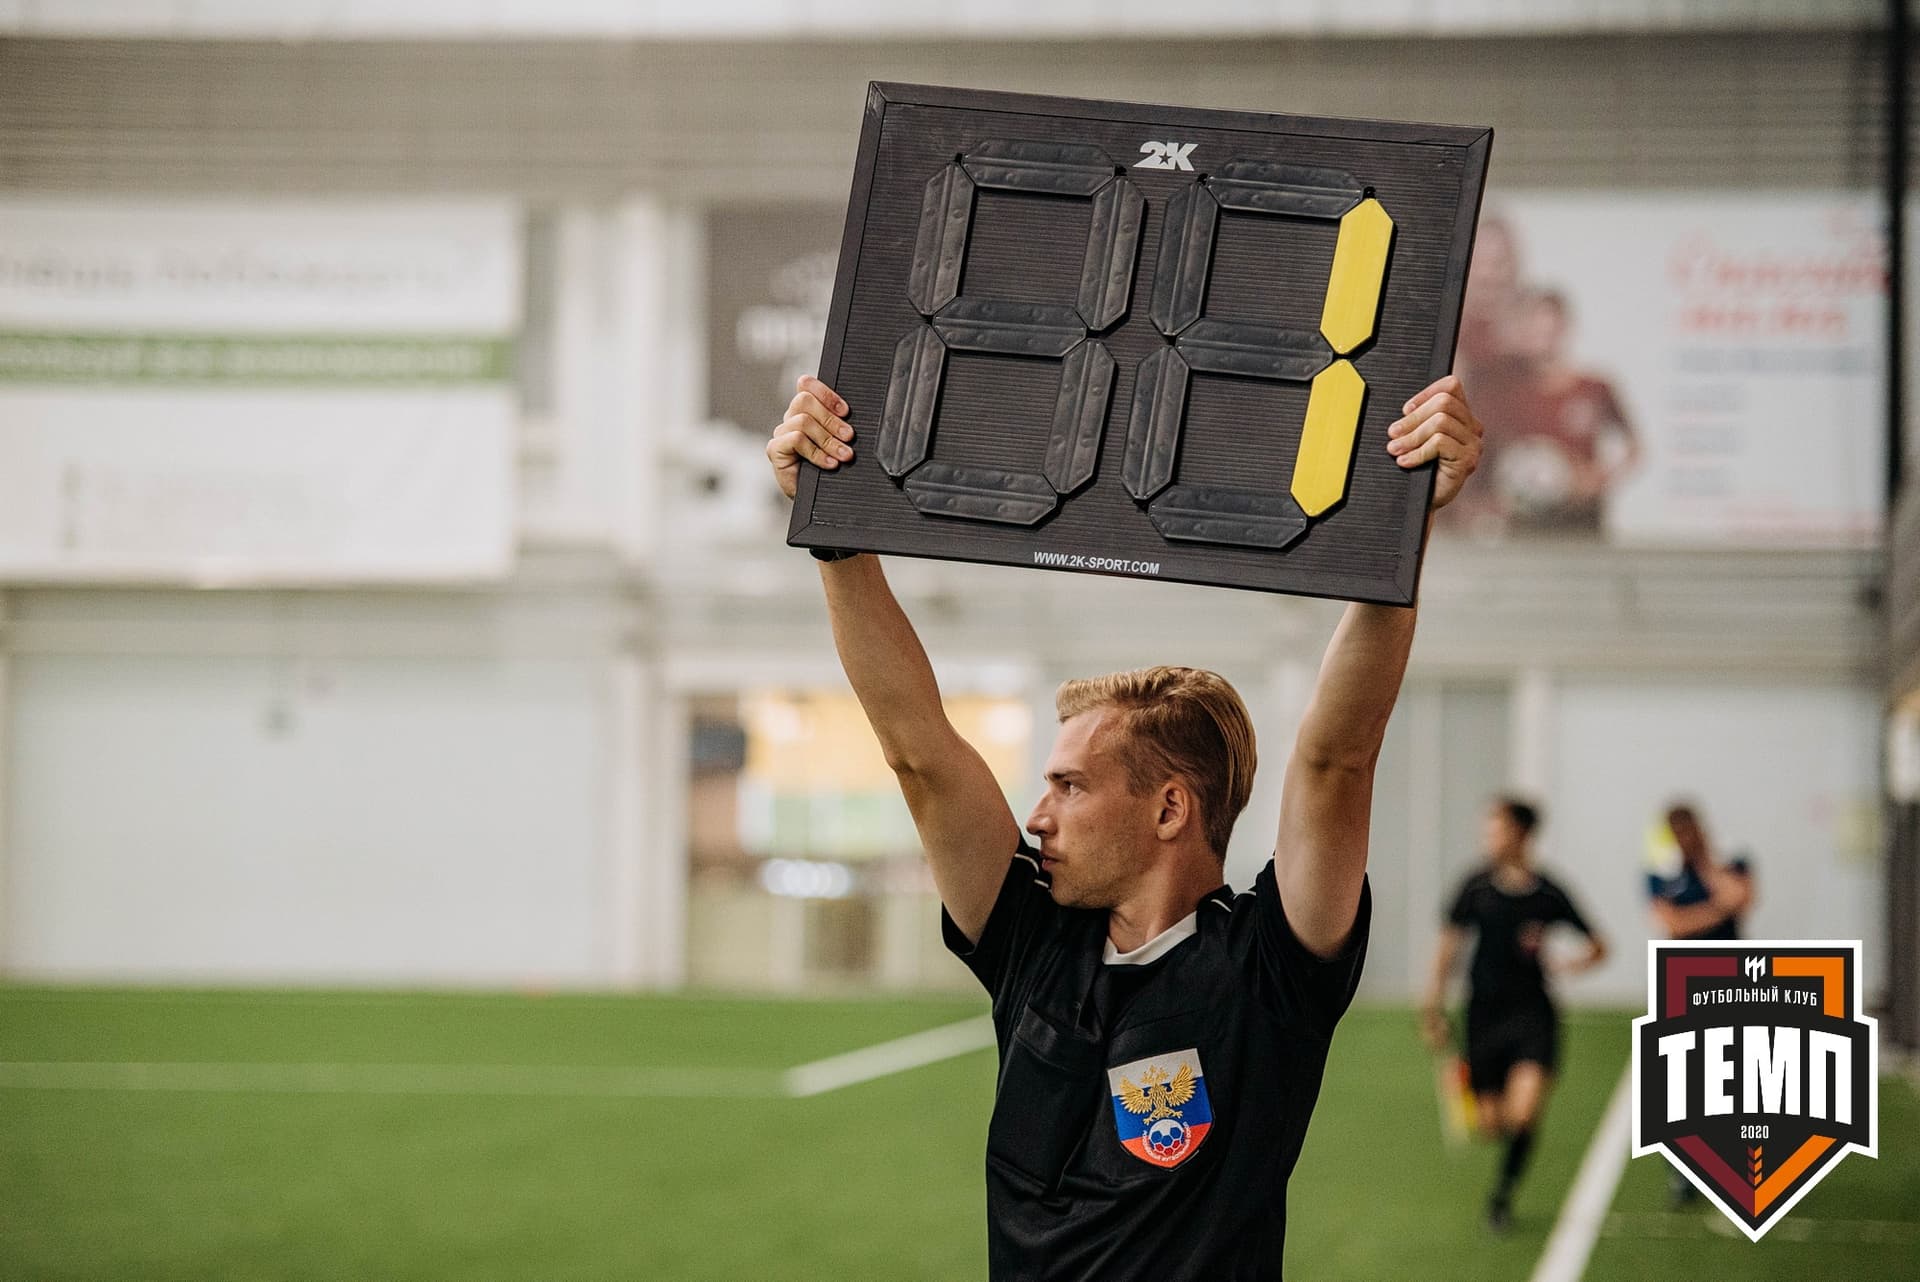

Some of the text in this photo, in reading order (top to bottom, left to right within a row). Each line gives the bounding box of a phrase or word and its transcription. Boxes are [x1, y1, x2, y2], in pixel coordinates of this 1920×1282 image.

[1132, 141, 1199, 172] 2K
[1291, 198, 1393, 517] 1
[1034, 551, 1160, 575] WWW.2K-SPORT.COM
